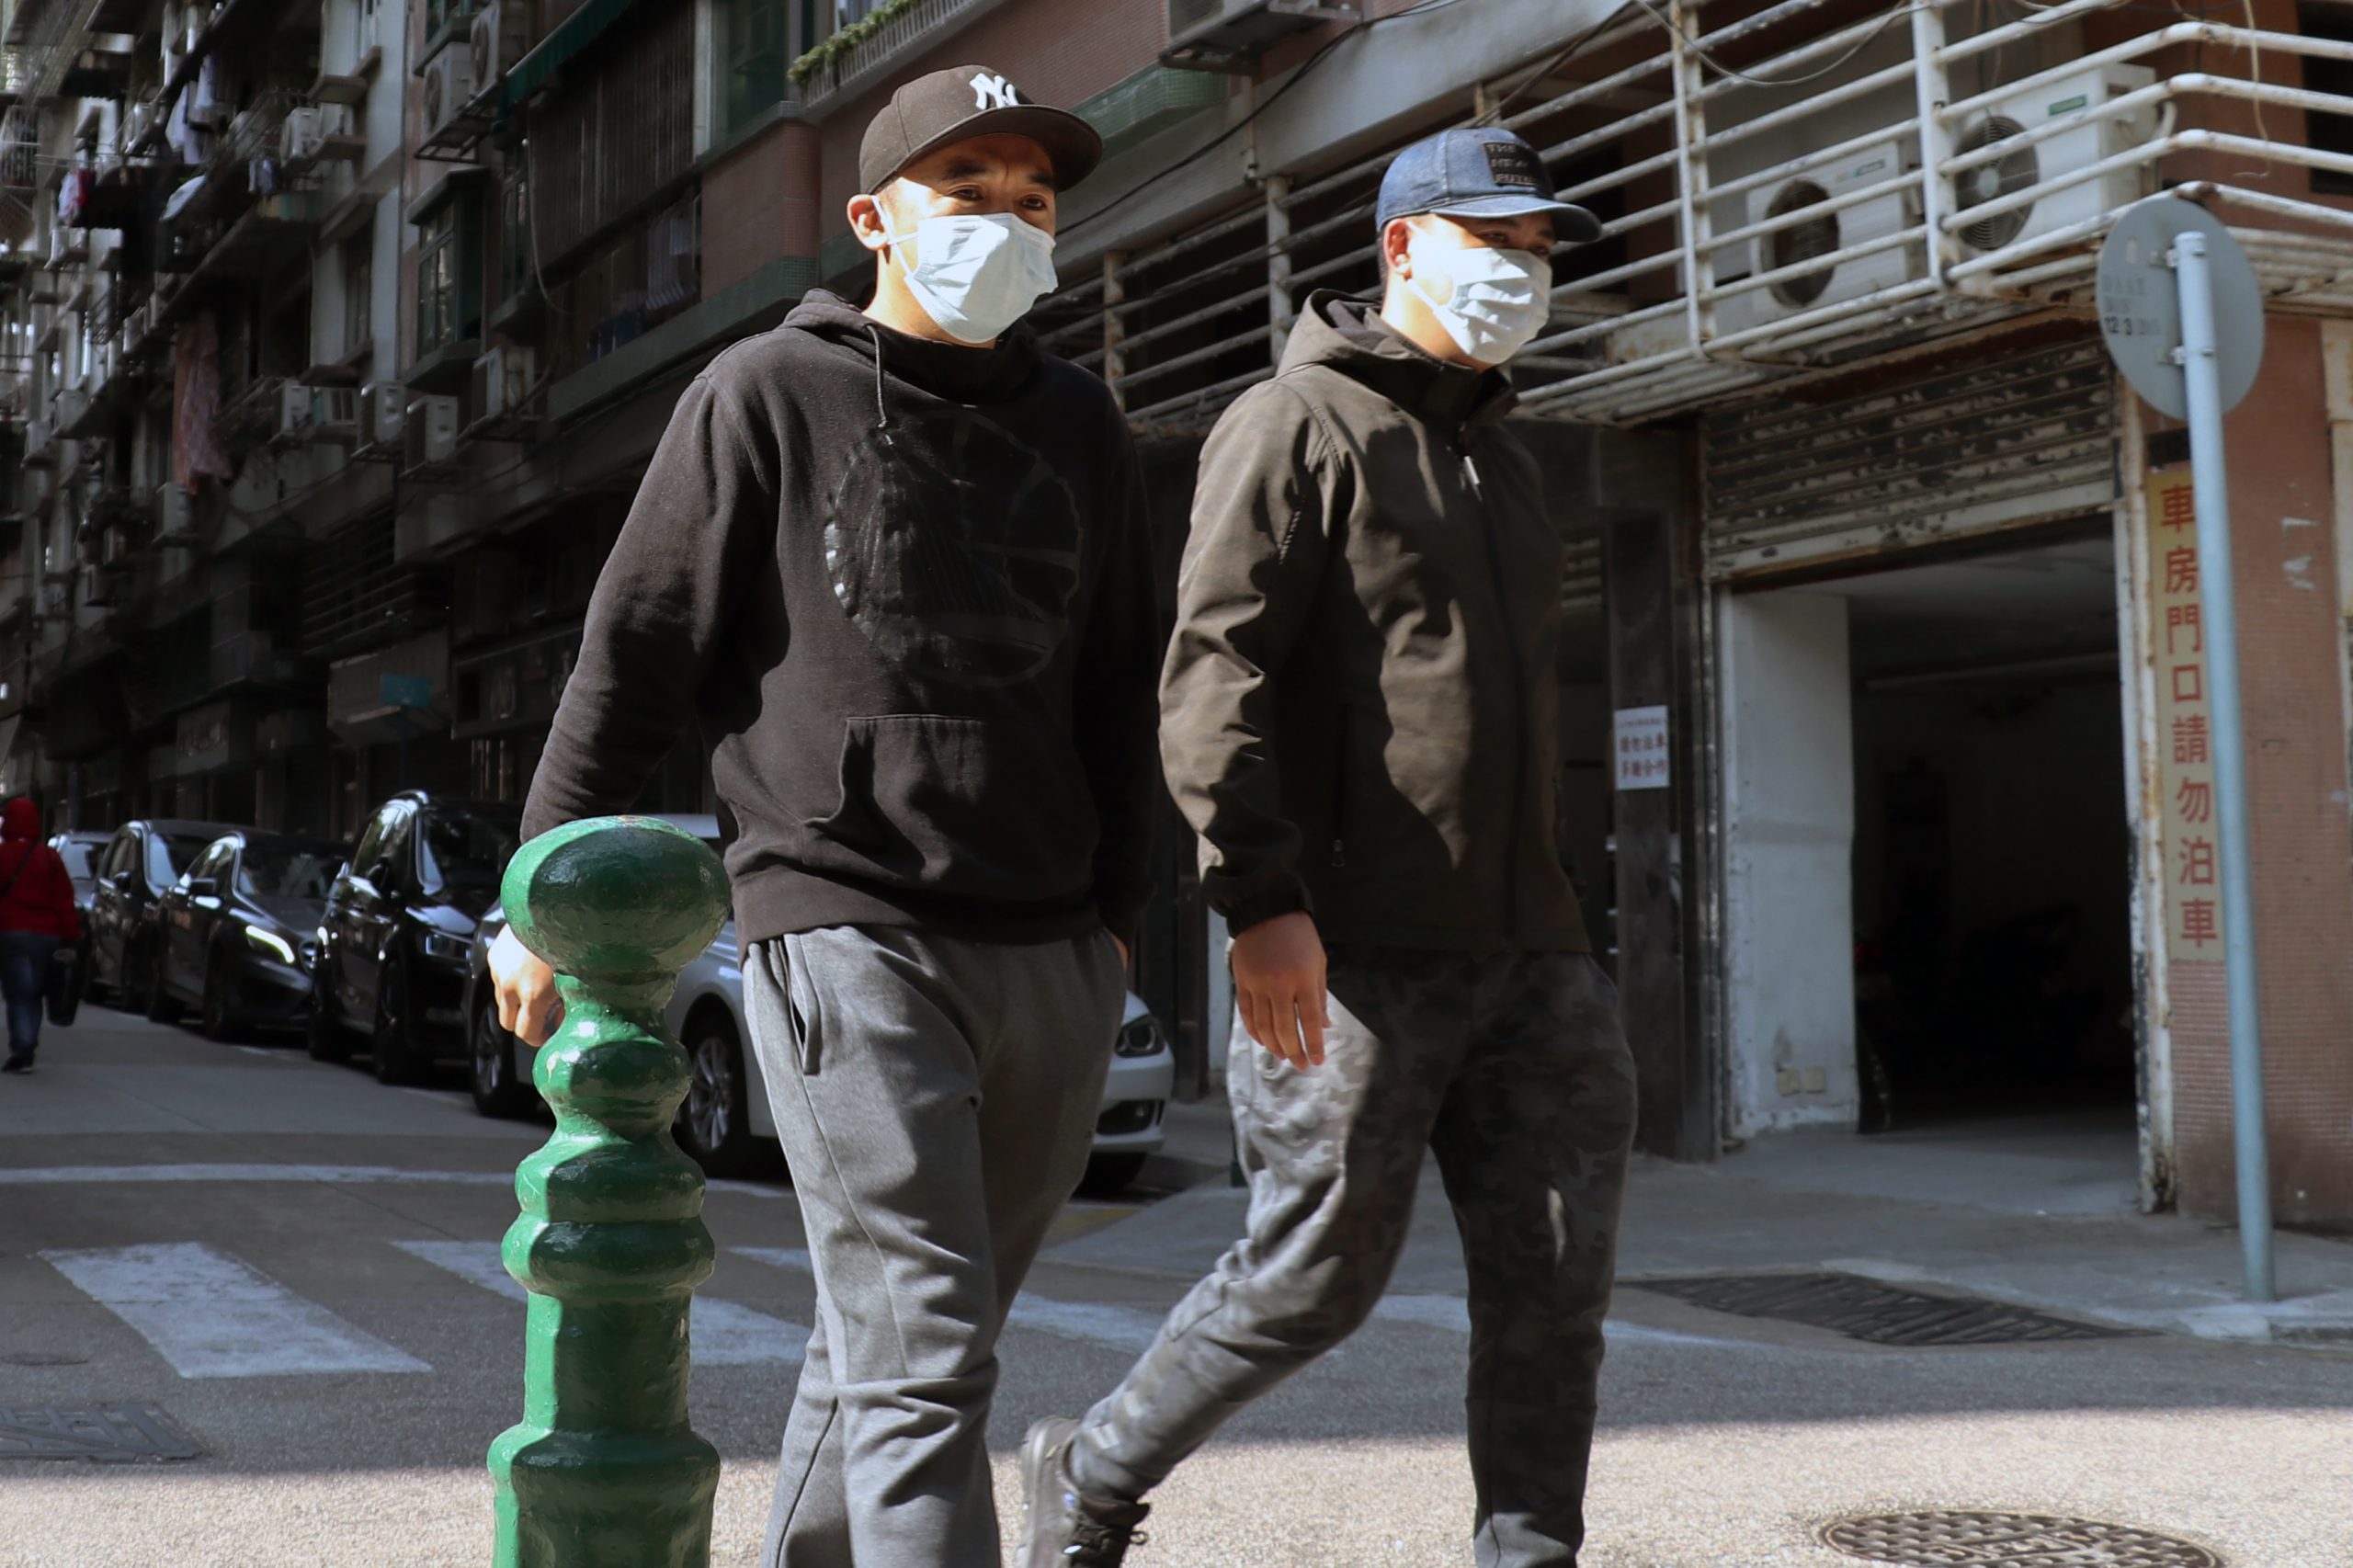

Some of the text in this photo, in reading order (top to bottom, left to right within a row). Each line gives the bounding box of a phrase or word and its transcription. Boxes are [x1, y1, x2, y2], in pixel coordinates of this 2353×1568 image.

[2161, 483, 2218, 949] 車房門口請勿泊車
